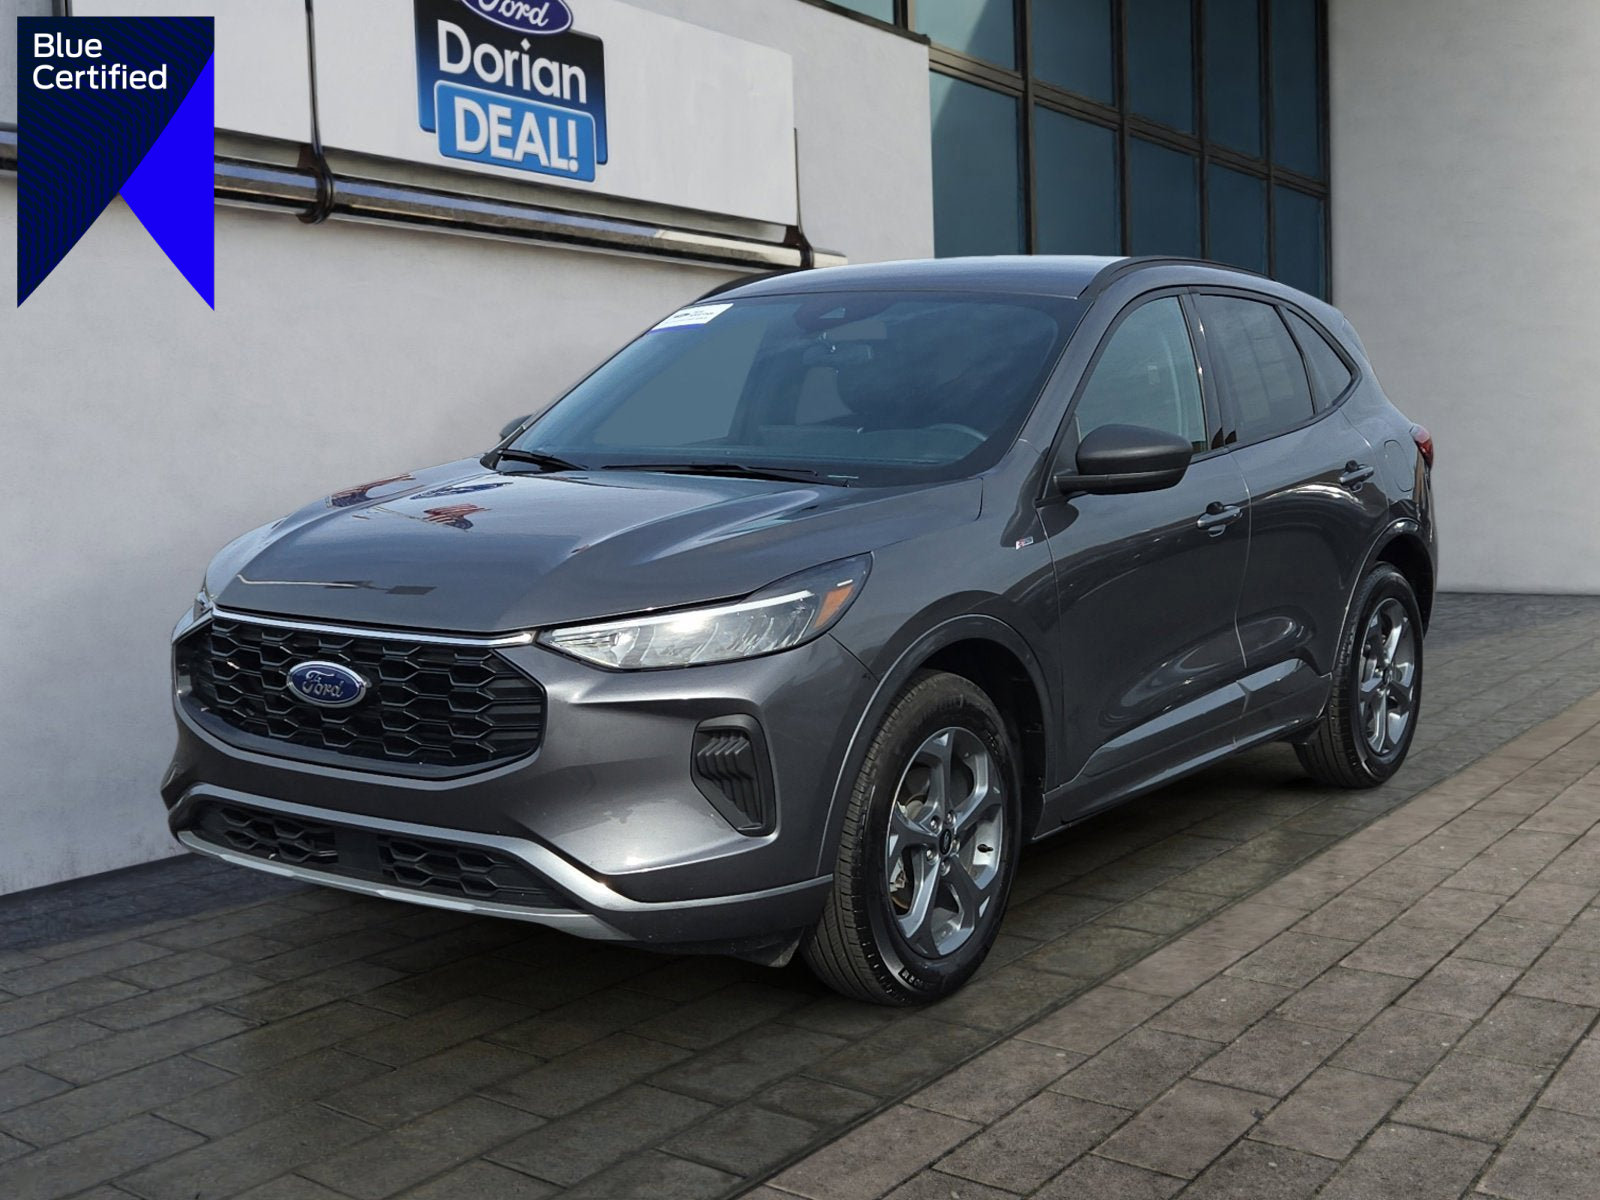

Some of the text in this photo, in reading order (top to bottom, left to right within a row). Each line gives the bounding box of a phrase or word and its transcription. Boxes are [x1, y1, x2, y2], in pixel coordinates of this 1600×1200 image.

[437, 19, 587, 104] Dorian
[454, 96, 579, 173] DEAL!
[302, 670, 344, 698] Ford
